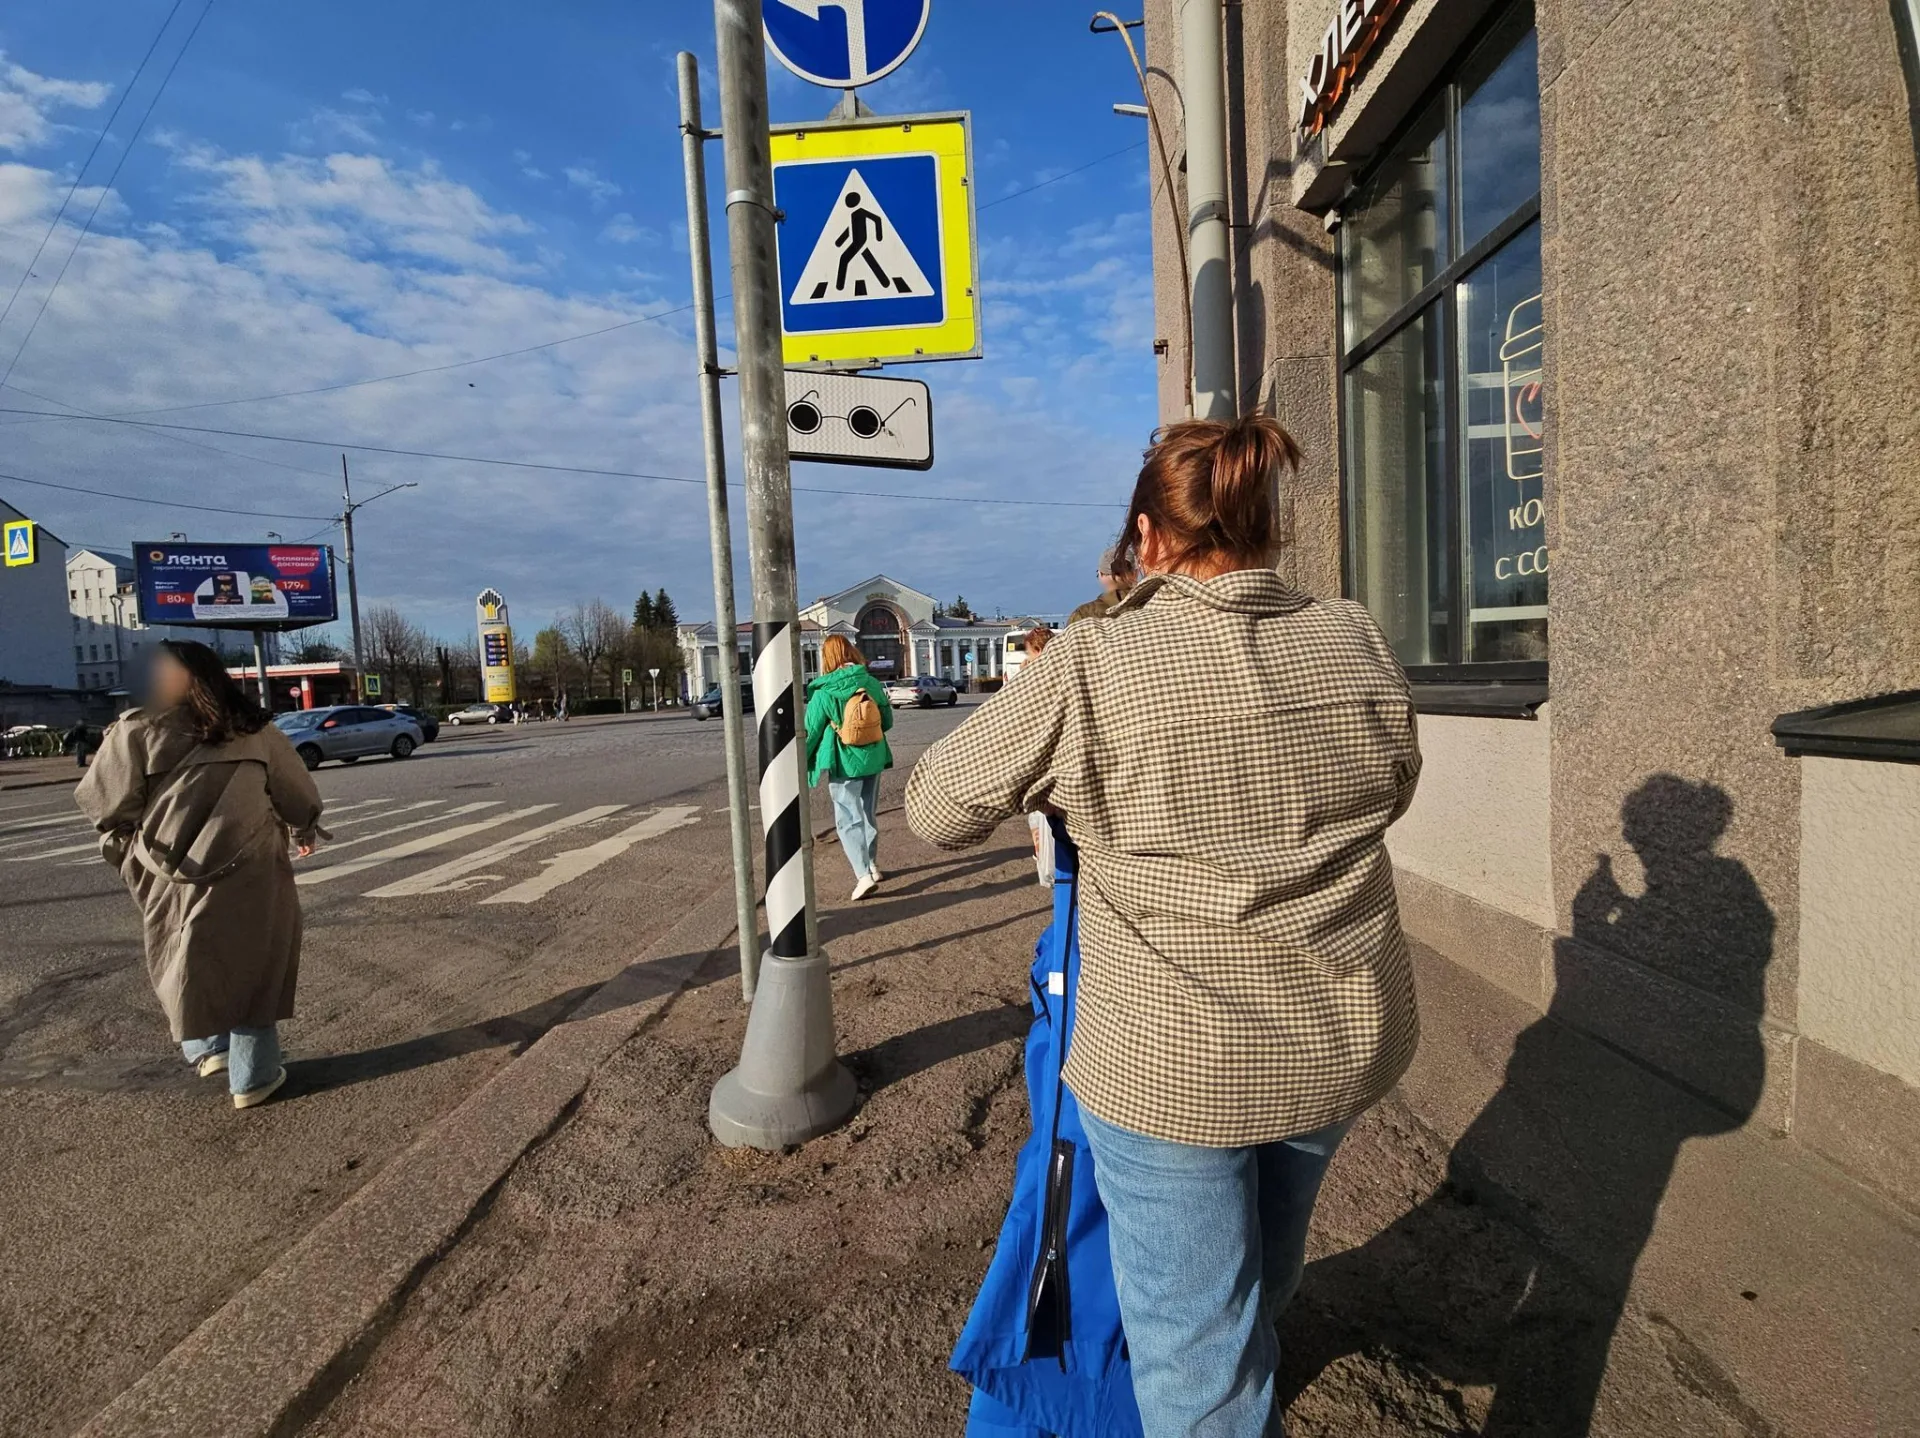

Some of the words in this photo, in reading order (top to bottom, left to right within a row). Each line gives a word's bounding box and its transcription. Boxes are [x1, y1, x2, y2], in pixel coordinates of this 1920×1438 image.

[1509, 498, 1545, 531] КО
[167, 555, 228, 566] лента
[1517, 545, 1549, 576] СО
